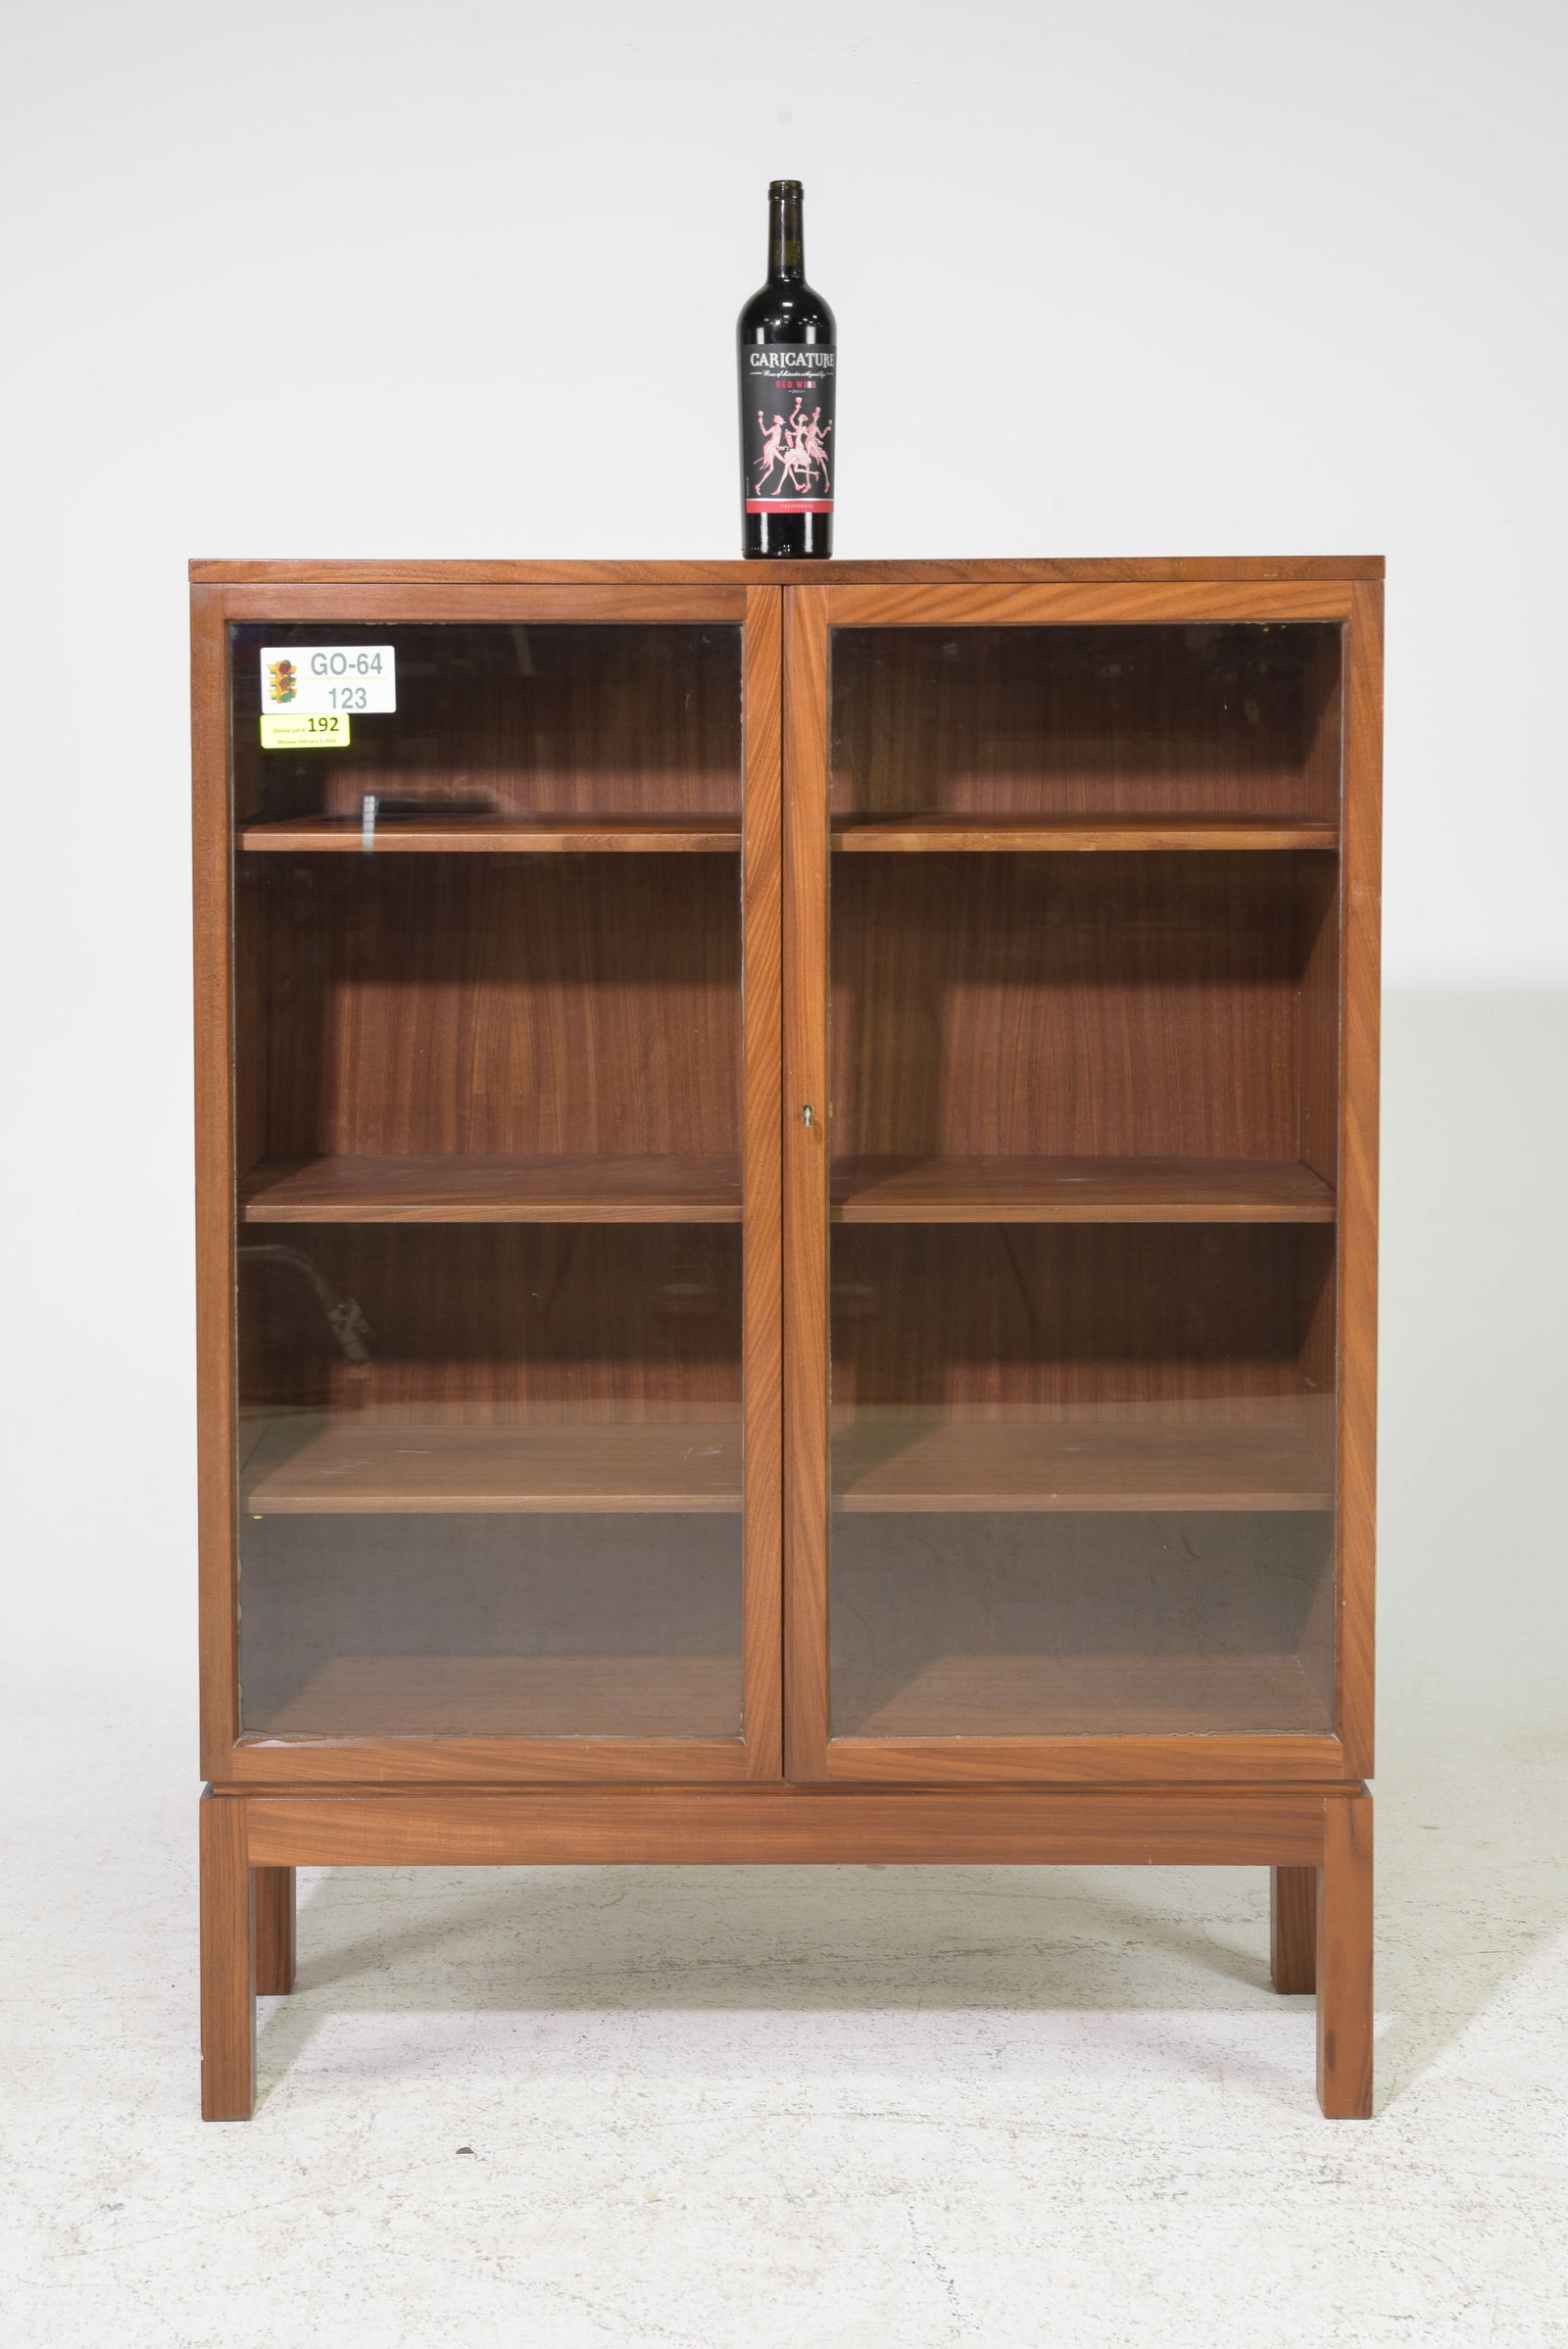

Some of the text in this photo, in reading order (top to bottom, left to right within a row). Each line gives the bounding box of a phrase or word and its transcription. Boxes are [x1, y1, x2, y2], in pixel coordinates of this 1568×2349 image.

[750, 353, 835, 367] CARICATURE
[775, 380, 816, 389] RED WINE
[311, 653, 383, 675] GO-64
[328, 687, 368, 710] 123
[308, 717, 339, 732] 192
